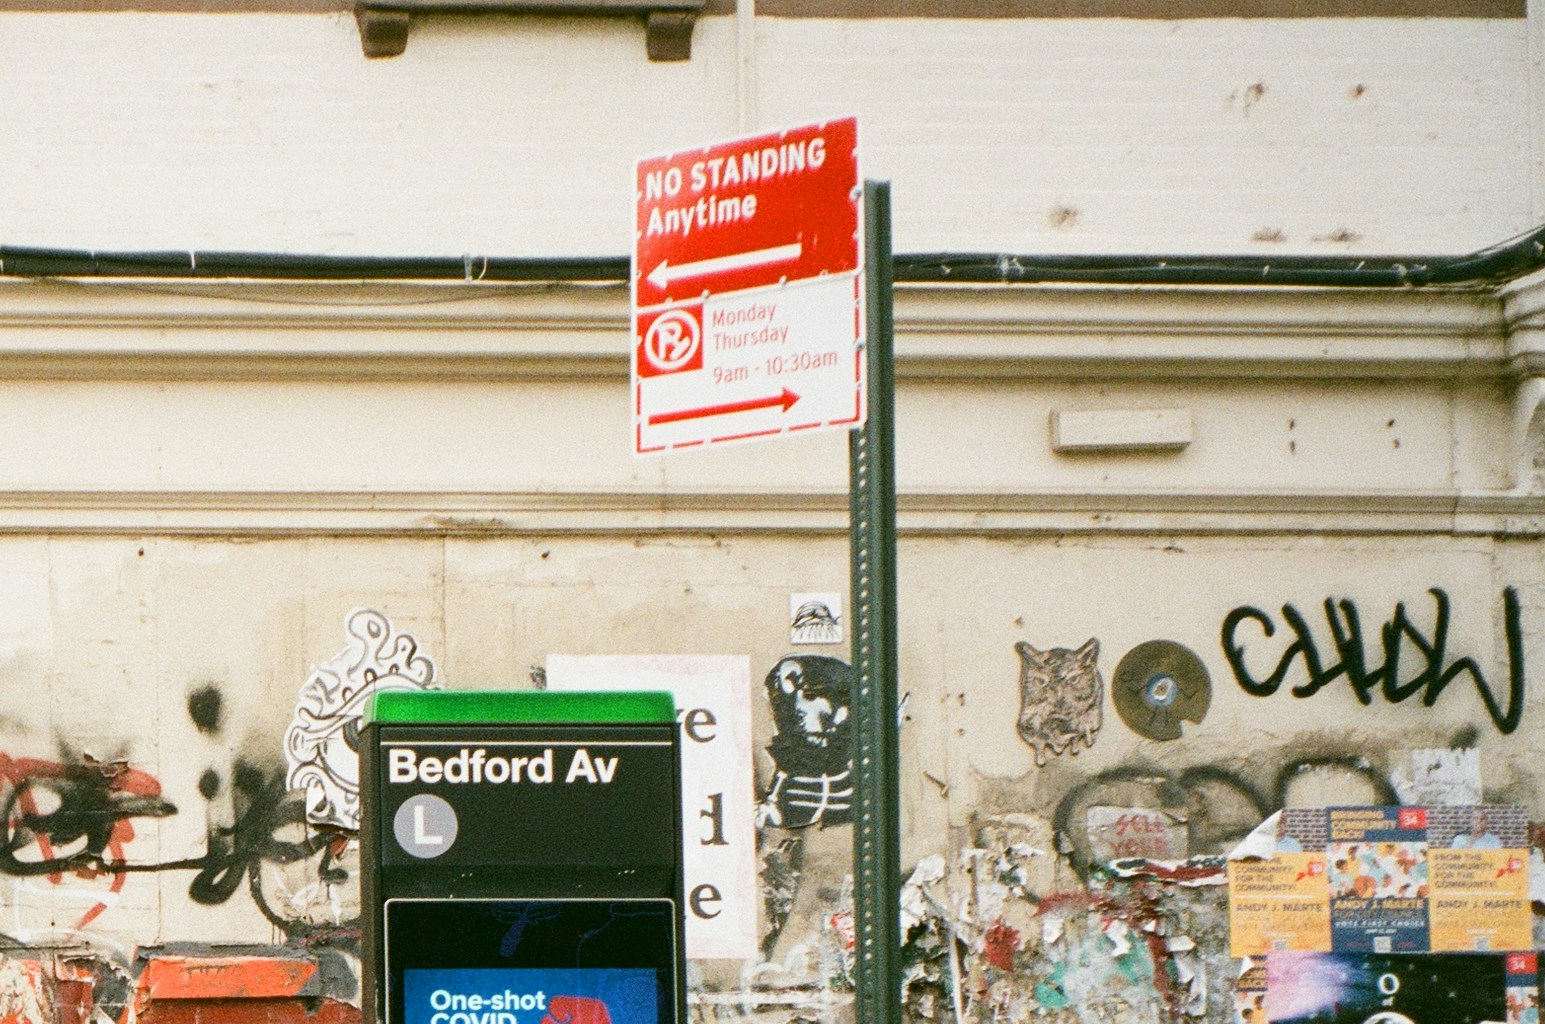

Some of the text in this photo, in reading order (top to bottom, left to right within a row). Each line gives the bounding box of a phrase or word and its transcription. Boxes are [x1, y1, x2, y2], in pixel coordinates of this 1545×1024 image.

[644, 138, 827, 200] NO STANDING
[647, 192, 757, 237] Anytime
[712, 302, 777, 330] Monday
[713, 323, 789, 353] Thursday
[713, 363, 749, 385] 9am
[765, 348, 838, 376] 10:30am
[389, 749, 618, 784] Bedford Av
[1236, 903, 1268, 912] ANDY
[1282, 902, 1323, 912] MARTE
[1334, 899, 1369, 910] ANDY
[1436, 900, 1470, 909] ANDY
[1484, 900, 1522, 909] MARTE
[430, 989, 546, 1011] One-shot
